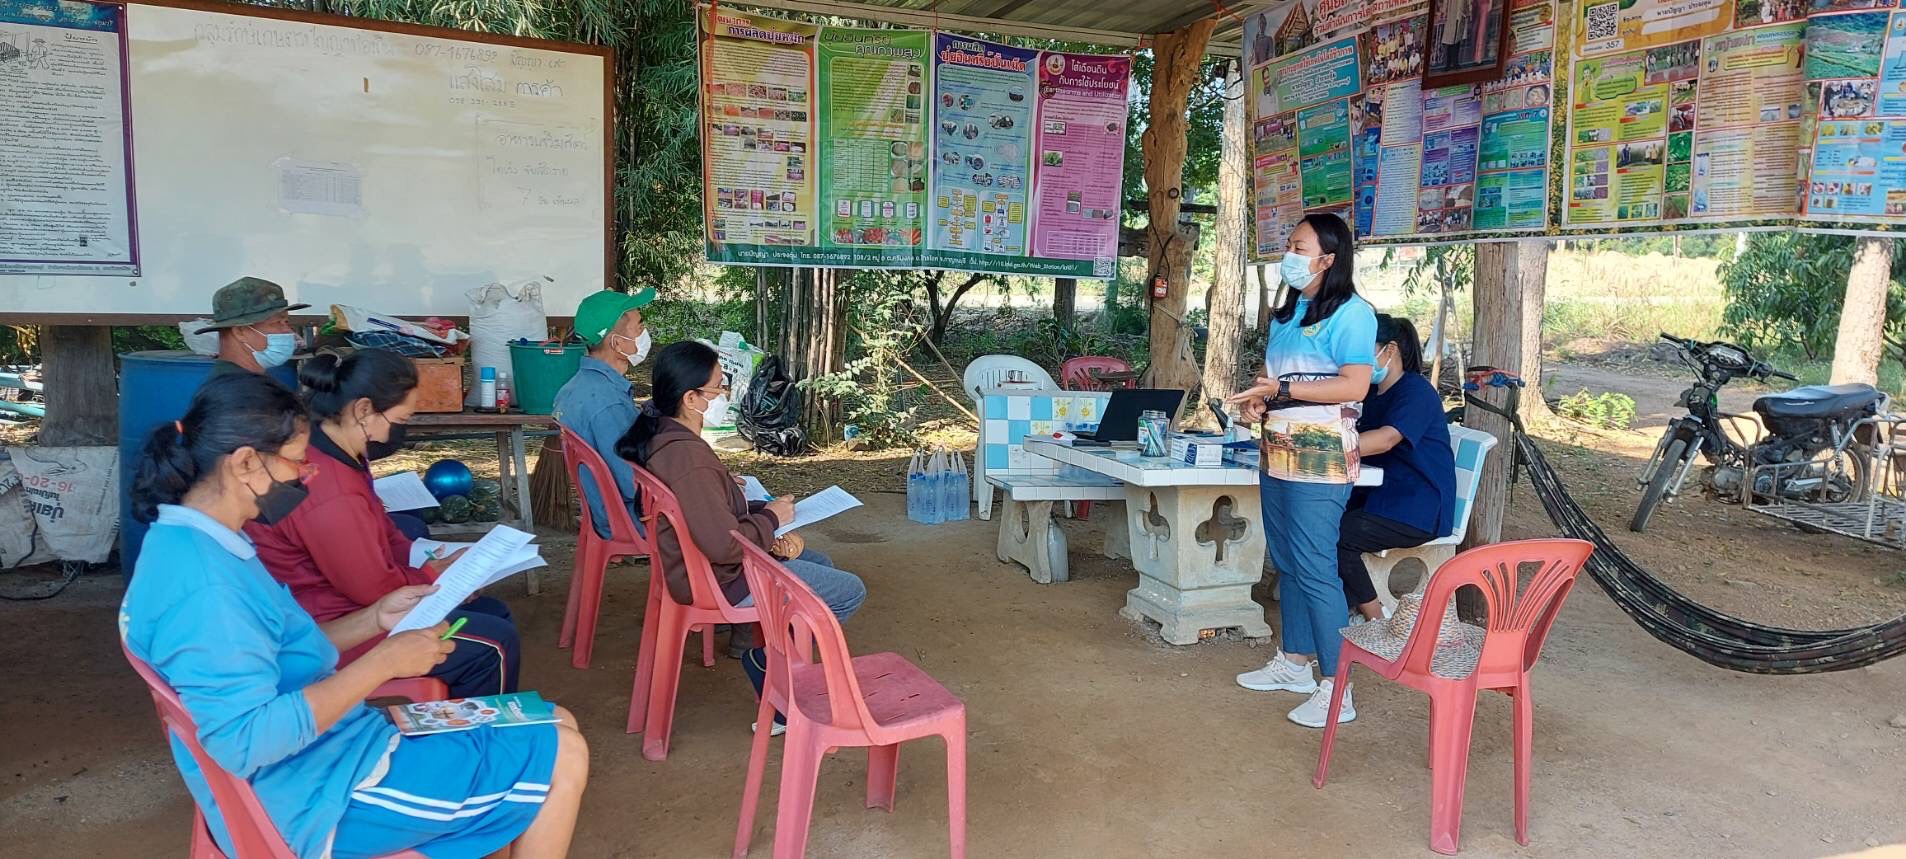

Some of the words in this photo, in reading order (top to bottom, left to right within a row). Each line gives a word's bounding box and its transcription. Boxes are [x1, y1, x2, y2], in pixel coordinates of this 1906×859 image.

[1605, 40, 1620, 50] 357
[1072, 60, 1107, 74] ไส้เดือนดิน
[1059, 75, 1119, 90] กับการใช้ประโยชน์
[21, 474, 74, 492] 16-20-
